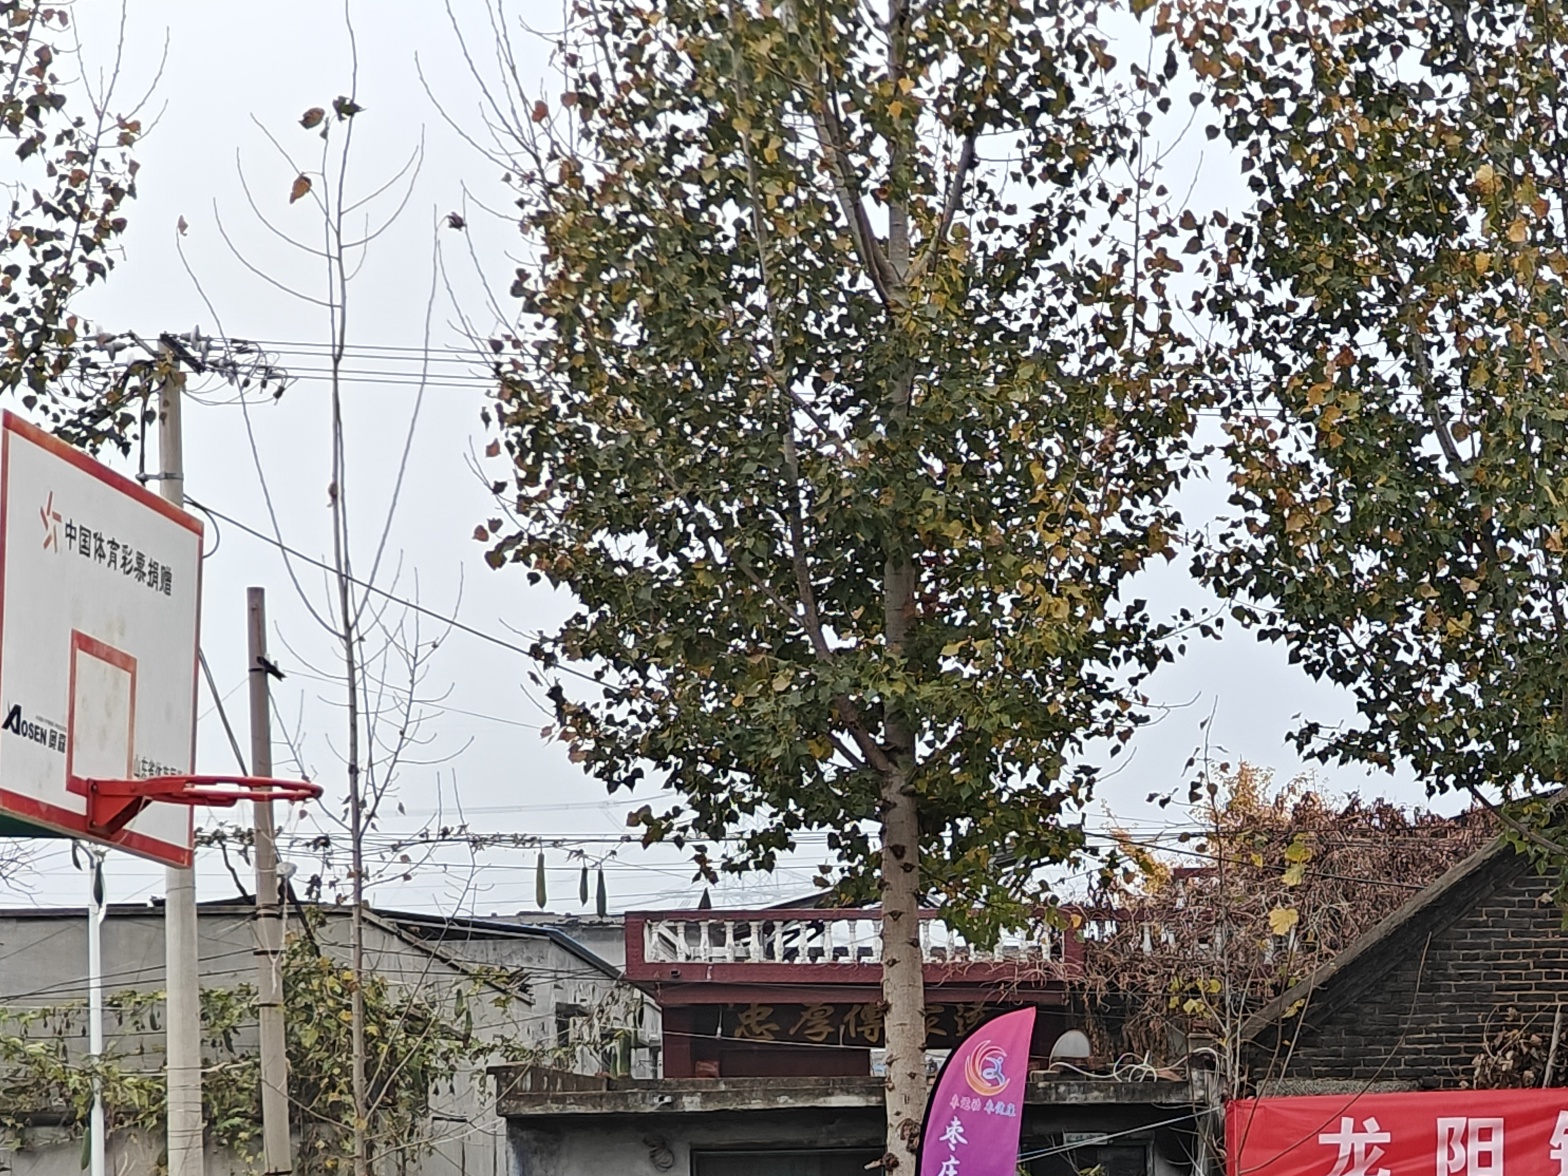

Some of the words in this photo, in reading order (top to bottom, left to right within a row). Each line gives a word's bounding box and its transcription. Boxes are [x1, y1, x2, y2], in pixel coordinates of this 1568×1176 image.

[65, 518, 172, 596] 中国体育彩票捐赠
[2, 702, 47, 746] AOSEN
